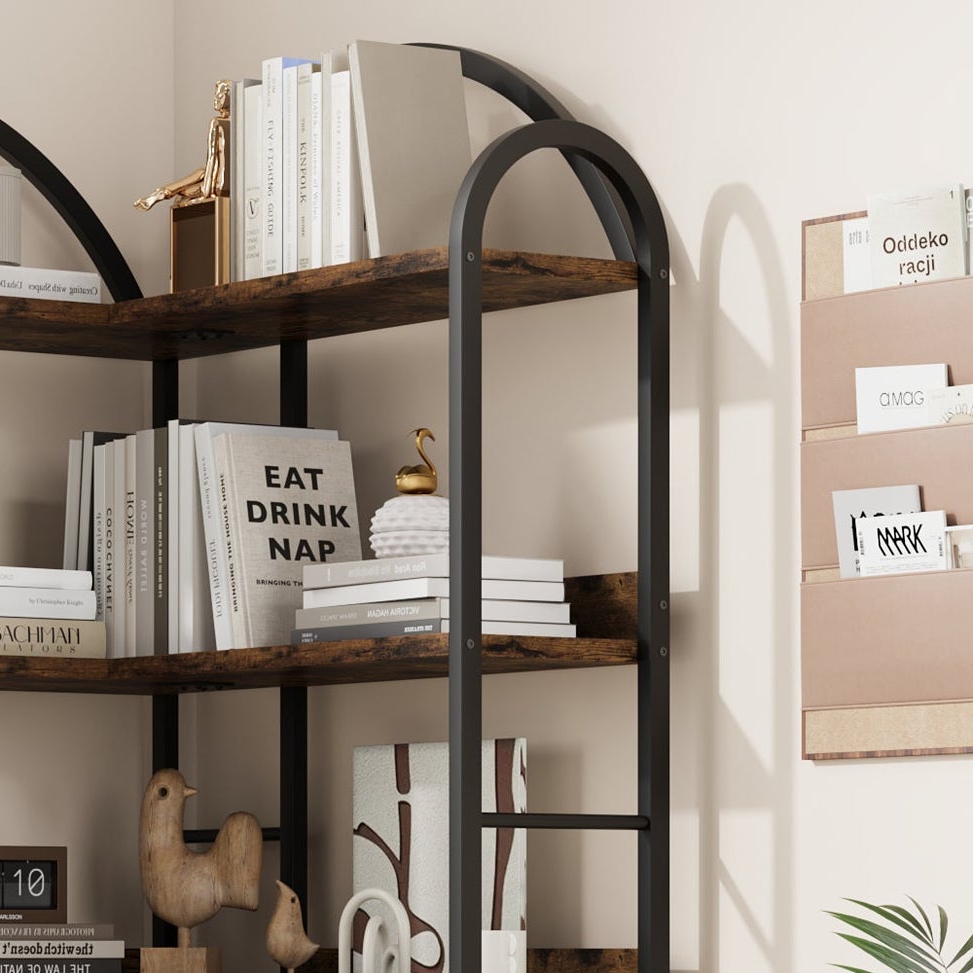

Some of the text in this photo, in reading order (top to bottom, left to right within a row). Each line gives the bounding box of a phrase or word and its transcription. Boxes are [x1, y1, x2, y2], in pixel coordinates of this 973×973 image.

[267, 119, 275, 198] FLY-FISHING
[299, 142, 308, 204] KINFOLK
[883, 231, 949, 254] Oddeko
[899, 254, 935, 276] racji
[264, 465, 324, 490] EAT
[246, 500, 351, 528] DRINK
[219, 473, 238, 612] BRINGING THE HOUSE HOME
[268, 537, 336, 562] NAP
[877, 524, 928, 557] MARK
[256, 579, 291, 587] BRINGING
[13, 868, 45, 897] 10
